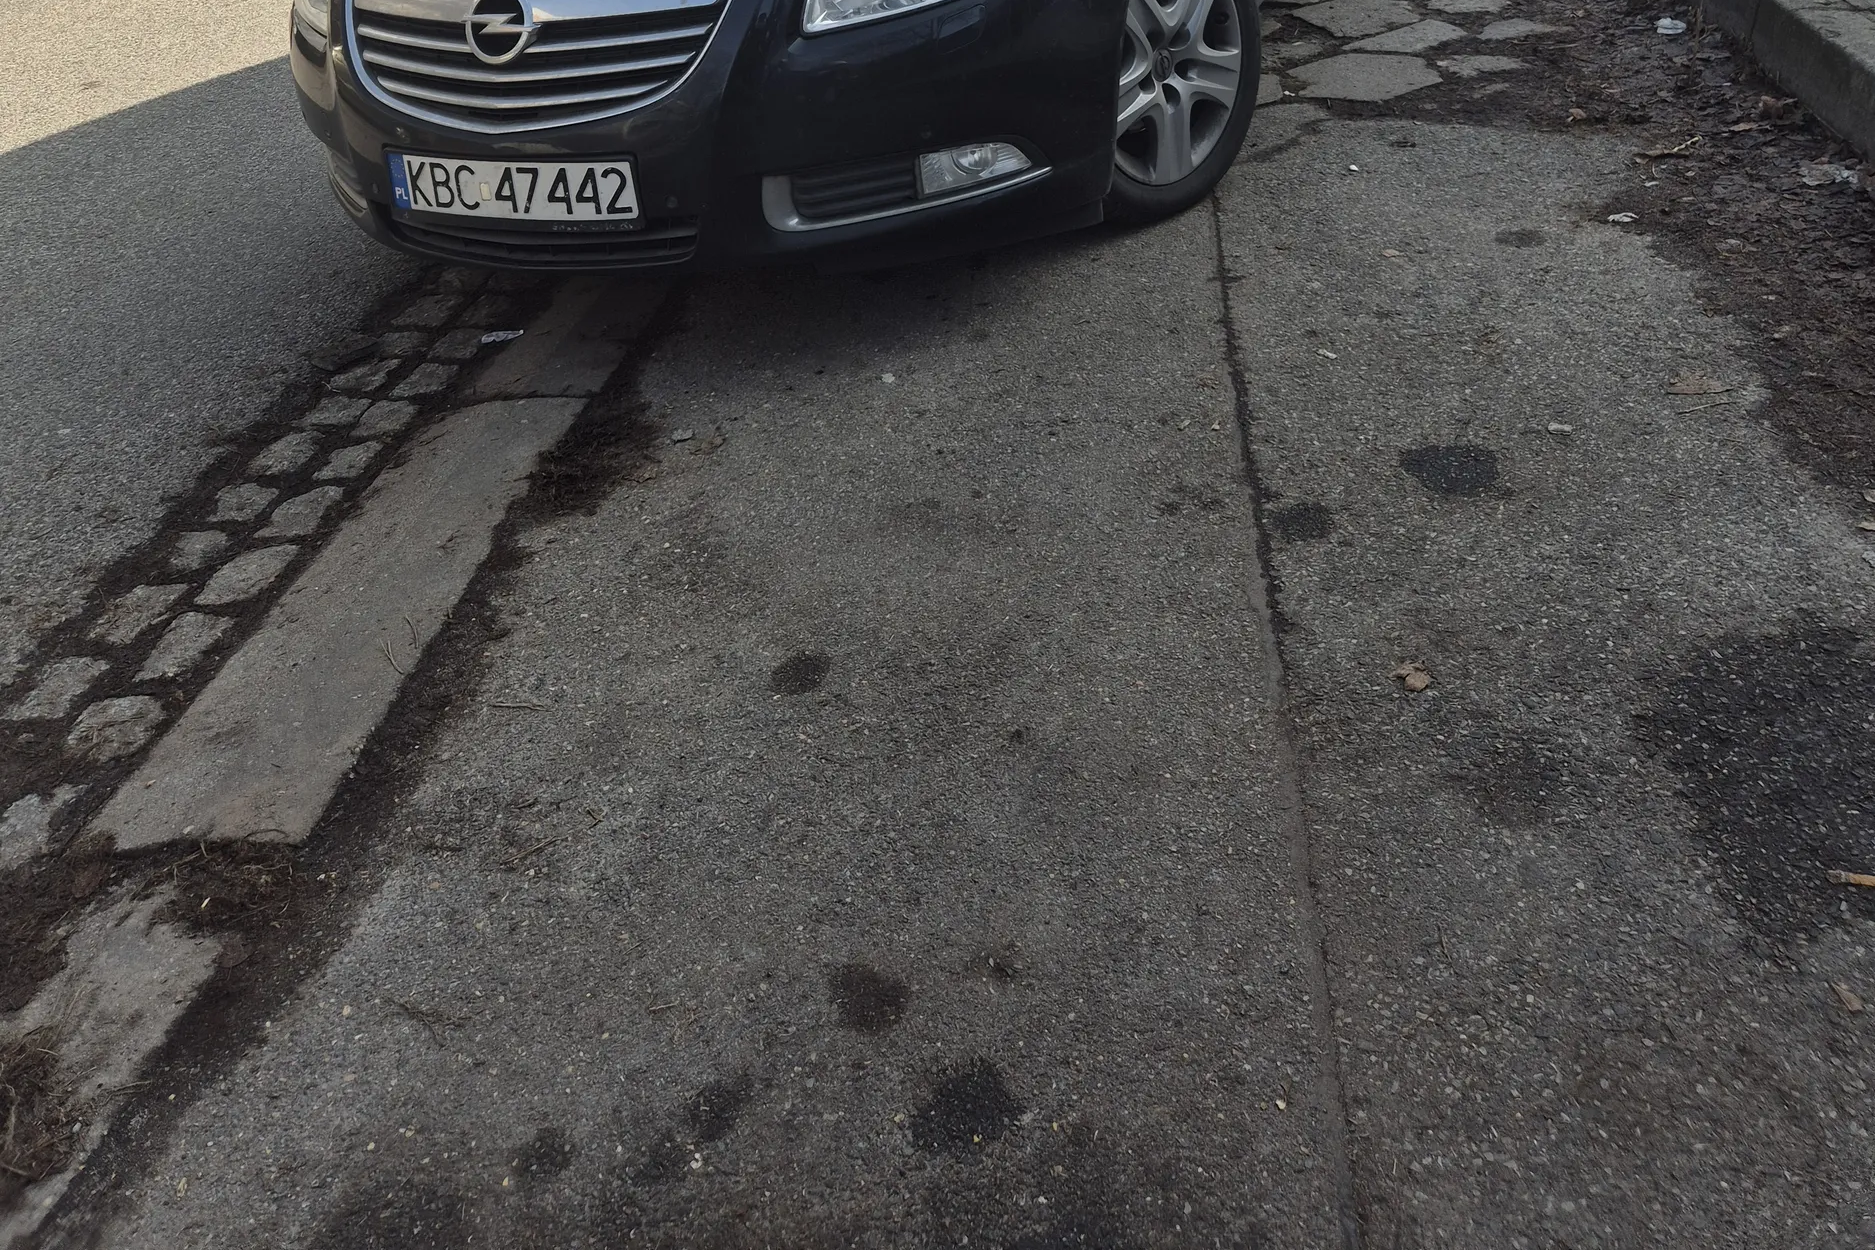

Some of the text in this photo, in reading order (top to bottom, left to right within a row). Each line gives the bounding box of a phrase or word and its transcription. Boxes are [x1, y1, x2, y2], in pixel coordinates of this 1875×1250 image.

[395, 186, 408, 200] PL
[407, 160, 633, 215] KBC 47442
